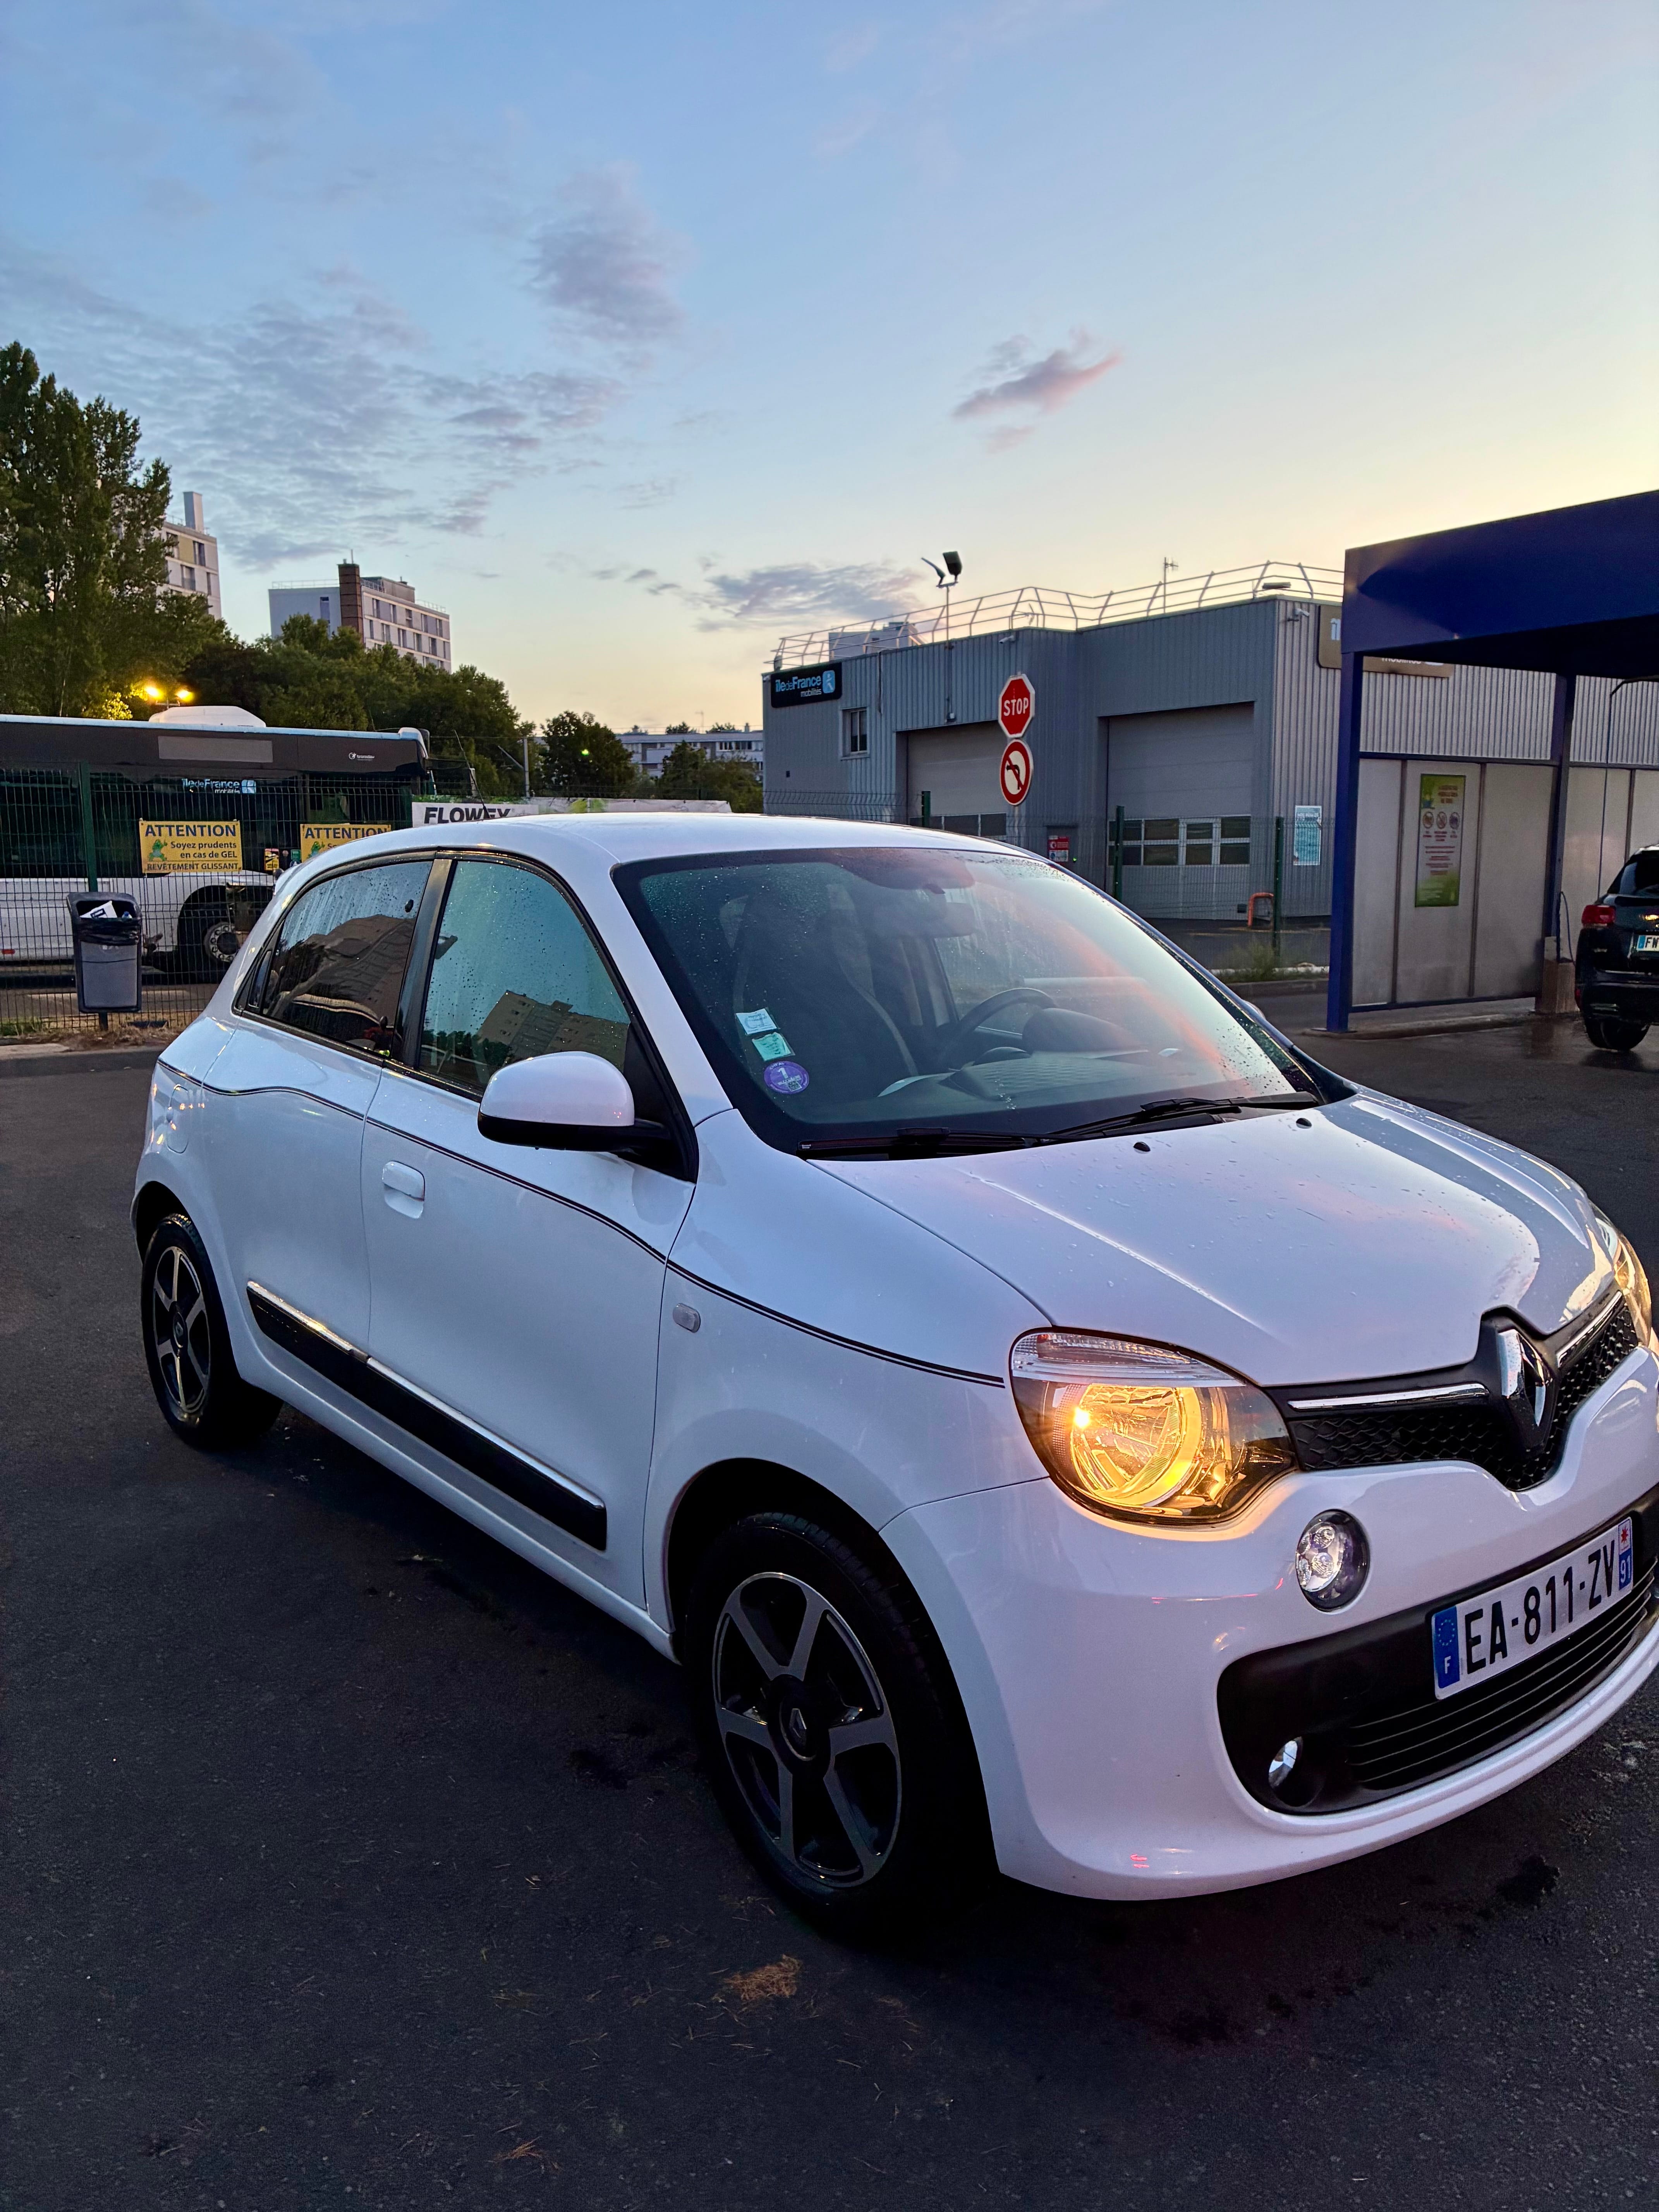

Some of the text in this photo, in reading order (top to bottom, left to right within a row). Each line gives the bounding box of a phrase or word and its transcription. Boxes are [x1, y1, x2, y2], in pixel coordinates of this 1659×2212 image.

[1003, 697, 1029, 716] STOP
[145, 824, 236, 837] ATTENTION
[170, 841, 237, 850] Soyez prudents
[777, 1067, 789, 1079] 1
[1444, 1540, 1631, 1674] F EA-811-ZV 91
